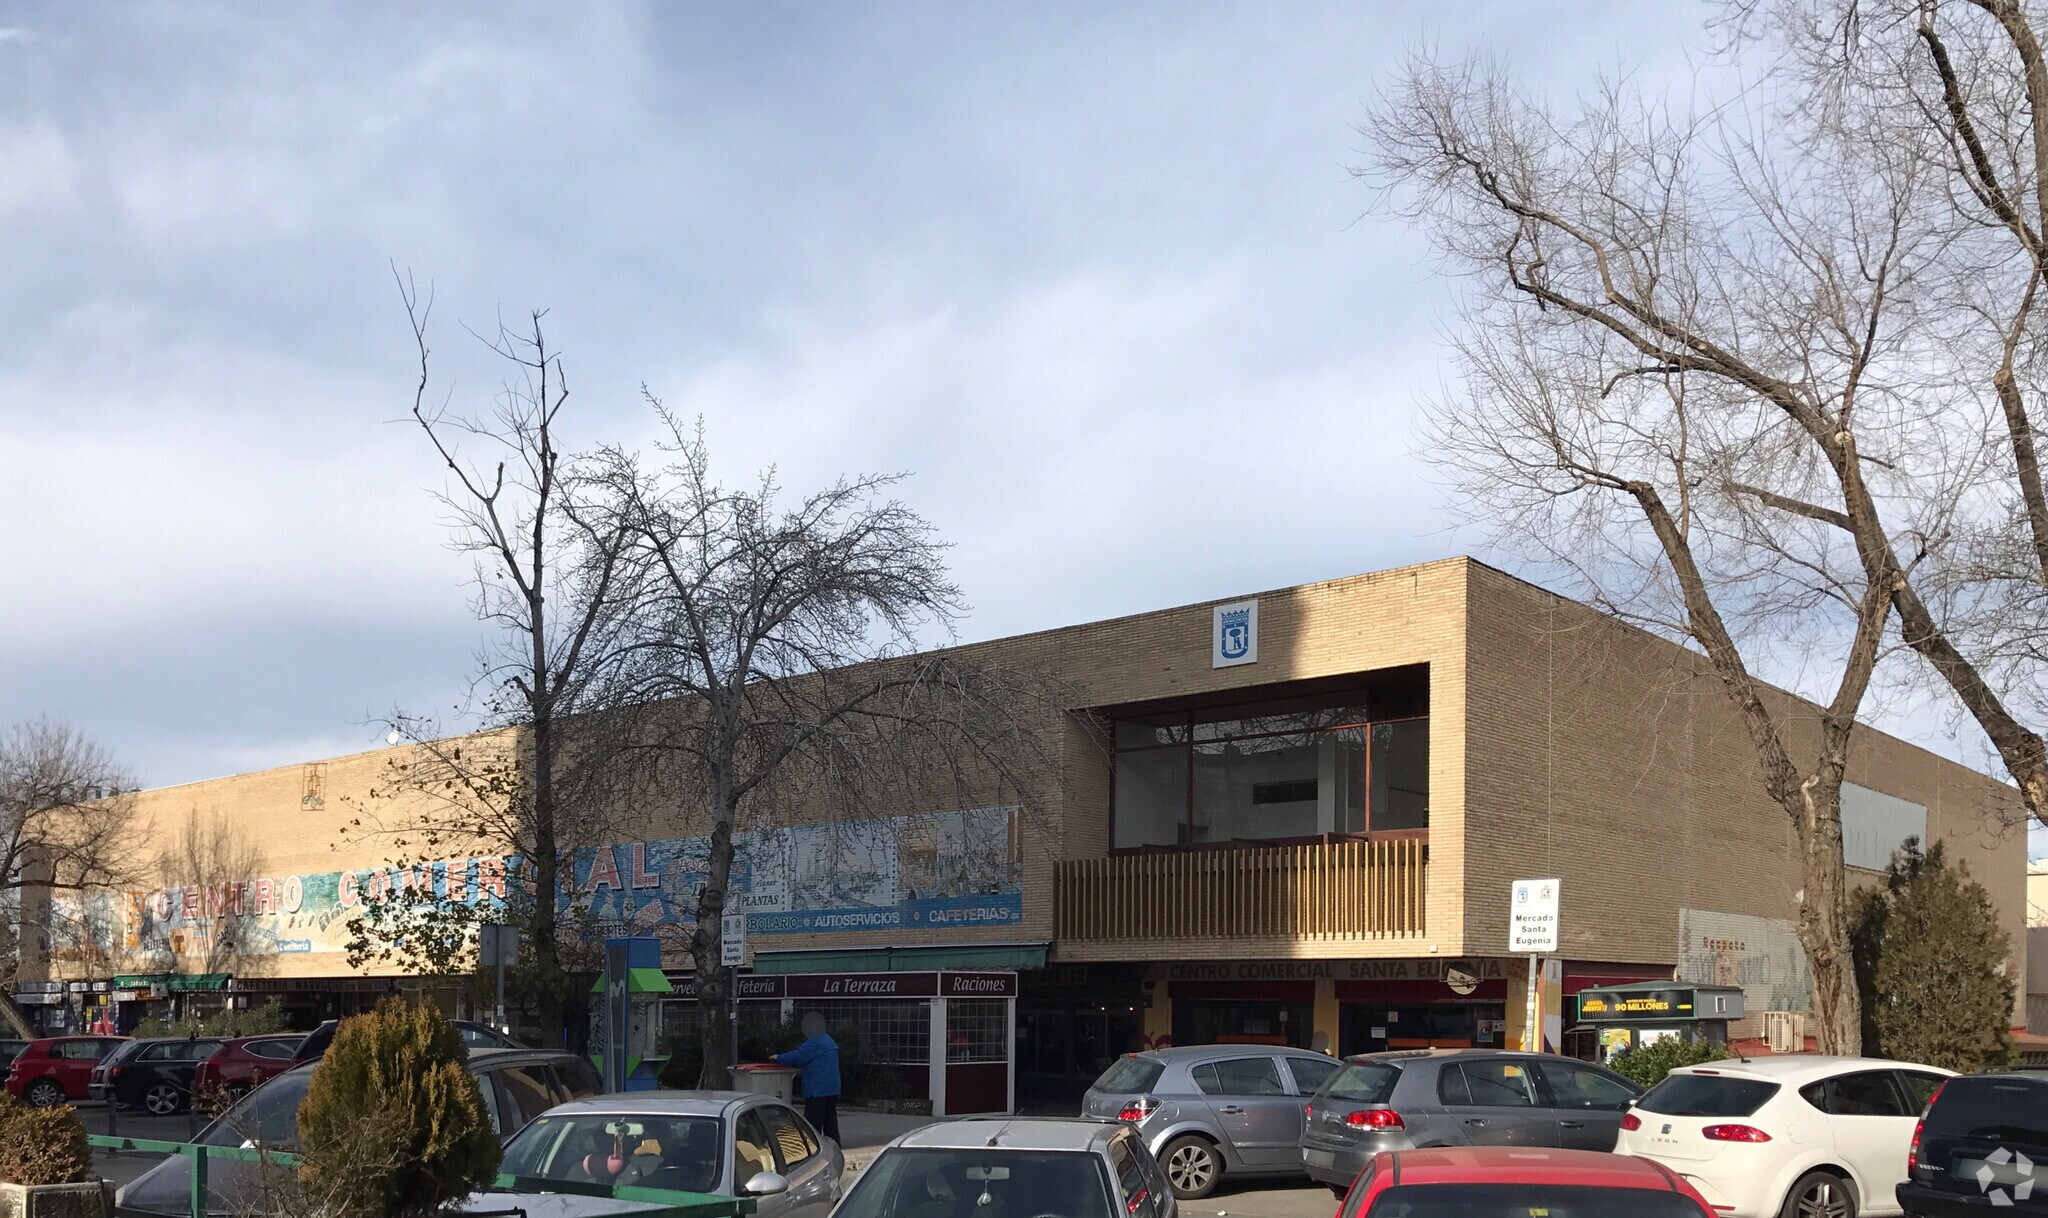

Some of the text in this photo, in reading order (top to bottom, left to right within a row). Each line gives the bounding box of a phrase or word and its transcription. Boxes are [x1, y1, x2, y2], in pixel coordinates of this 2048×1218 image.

[156, 875, 303, 922] CENTRO
[741, 894, 779, 906] PLANTAS
[814, 911, 900, 928] AUTOSERVICIOS
[928, 907, 1009, 923] CAFETERIAS
[1515, 914, 1554, 922] Mercado
[1521, 925, 1547, 933] Santa
[1516, 937, 1551, 945] Eugenia
[1170, 962, 1230, 979] CENTRO
[1238, 961, 1333, 979] COMERCIAL
[1349, 961, 1409, 978] SANTA
[236, 980, 288, 991] CAFETERIA
[823, 979, 897, 993] La Terraza
[952, 977, 1006, 992] Raciones
[1614, 1003, 1627, 1011] 90
[1627, 1002, 1669, 1011] MILLONES
